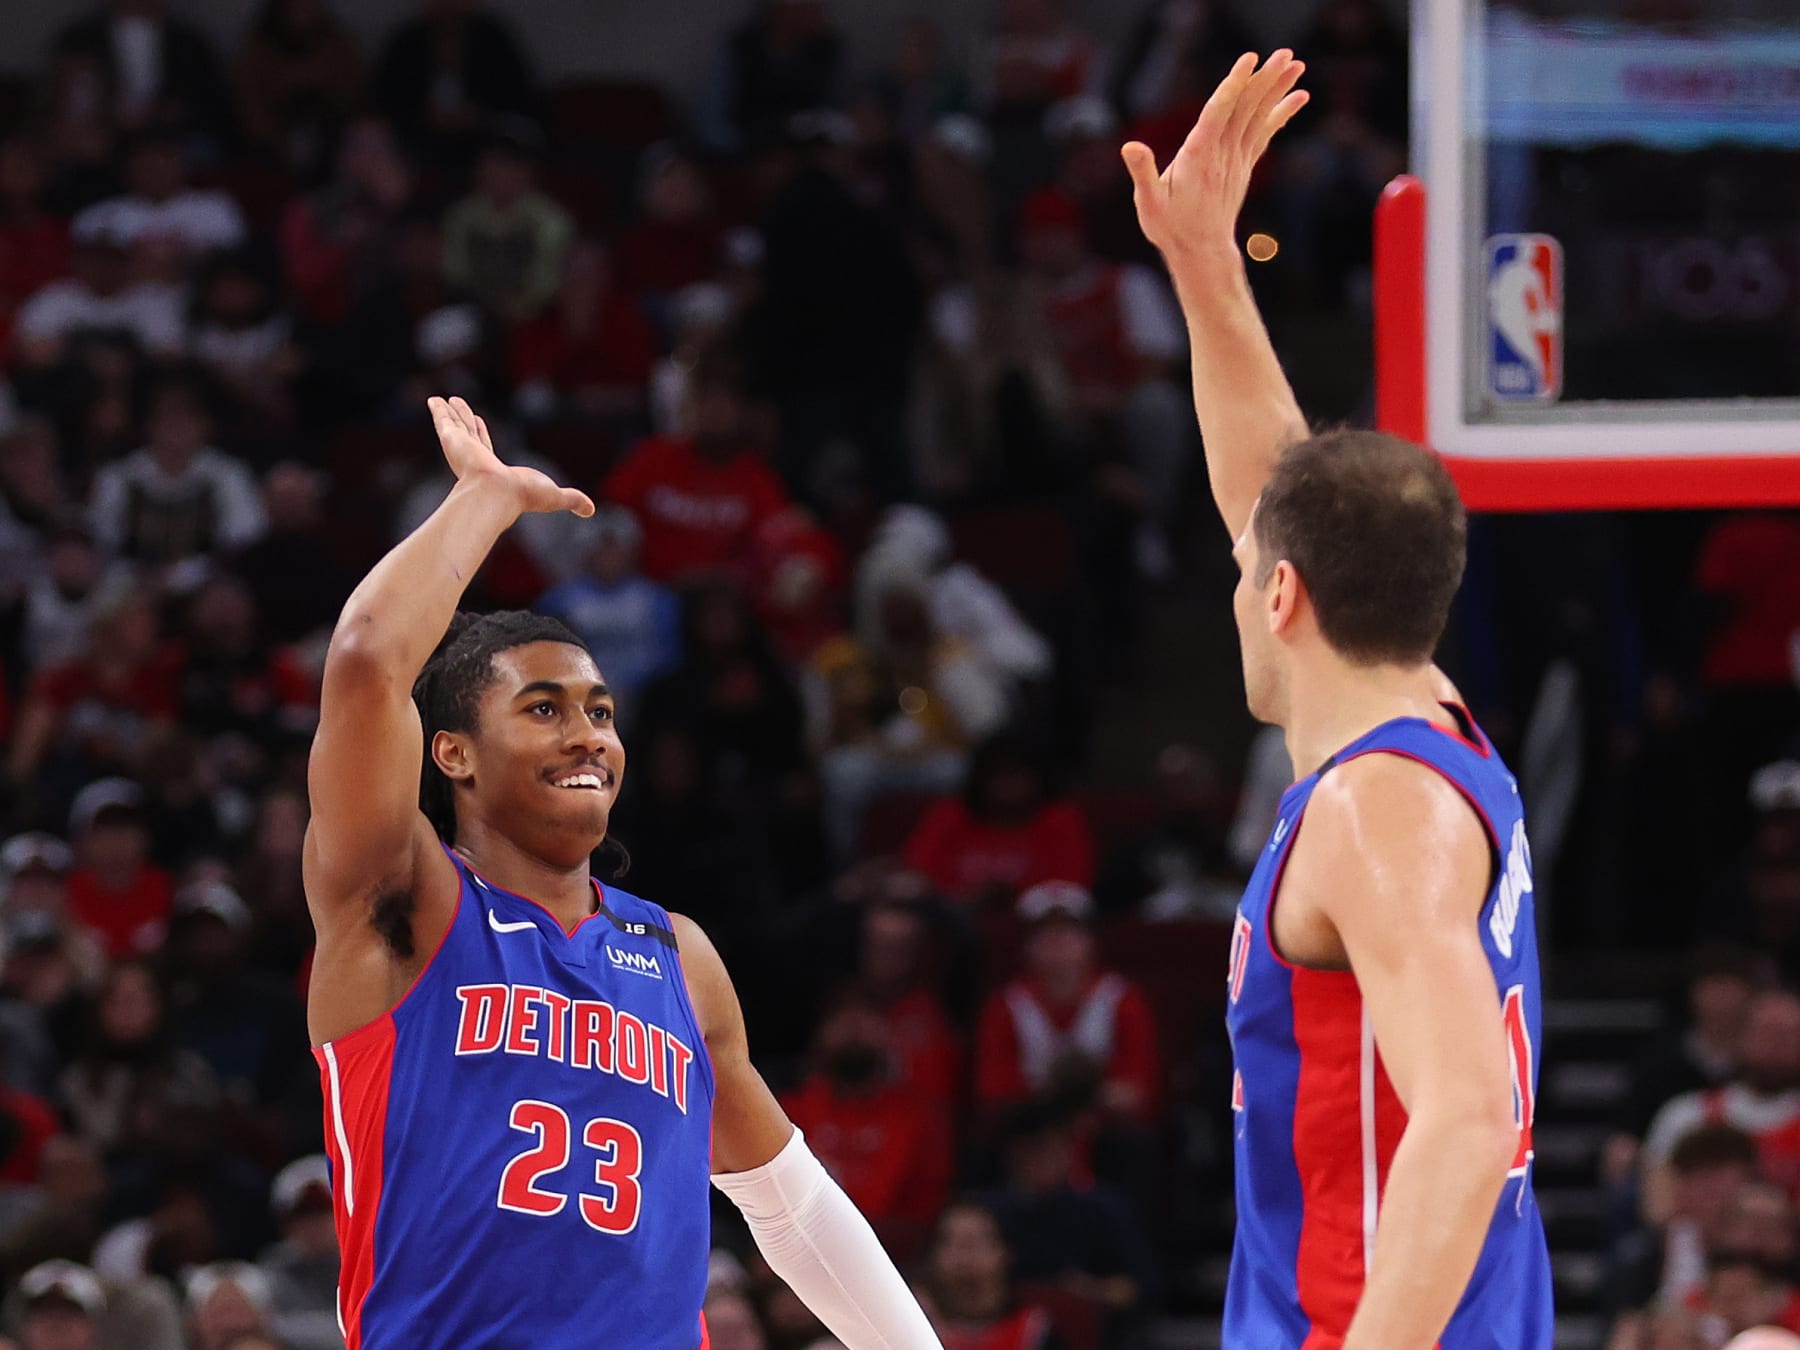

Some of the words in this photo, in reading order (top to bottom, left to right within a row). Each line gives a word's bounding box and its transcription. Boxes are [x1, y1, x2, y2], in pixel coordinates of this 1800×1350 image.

[606, 945, 661, 974] UWM
[625, 923, 646, 935] 16
[455, 984, 694, 1116] DETROIT
[497, 1099, 642, 1235] 23
